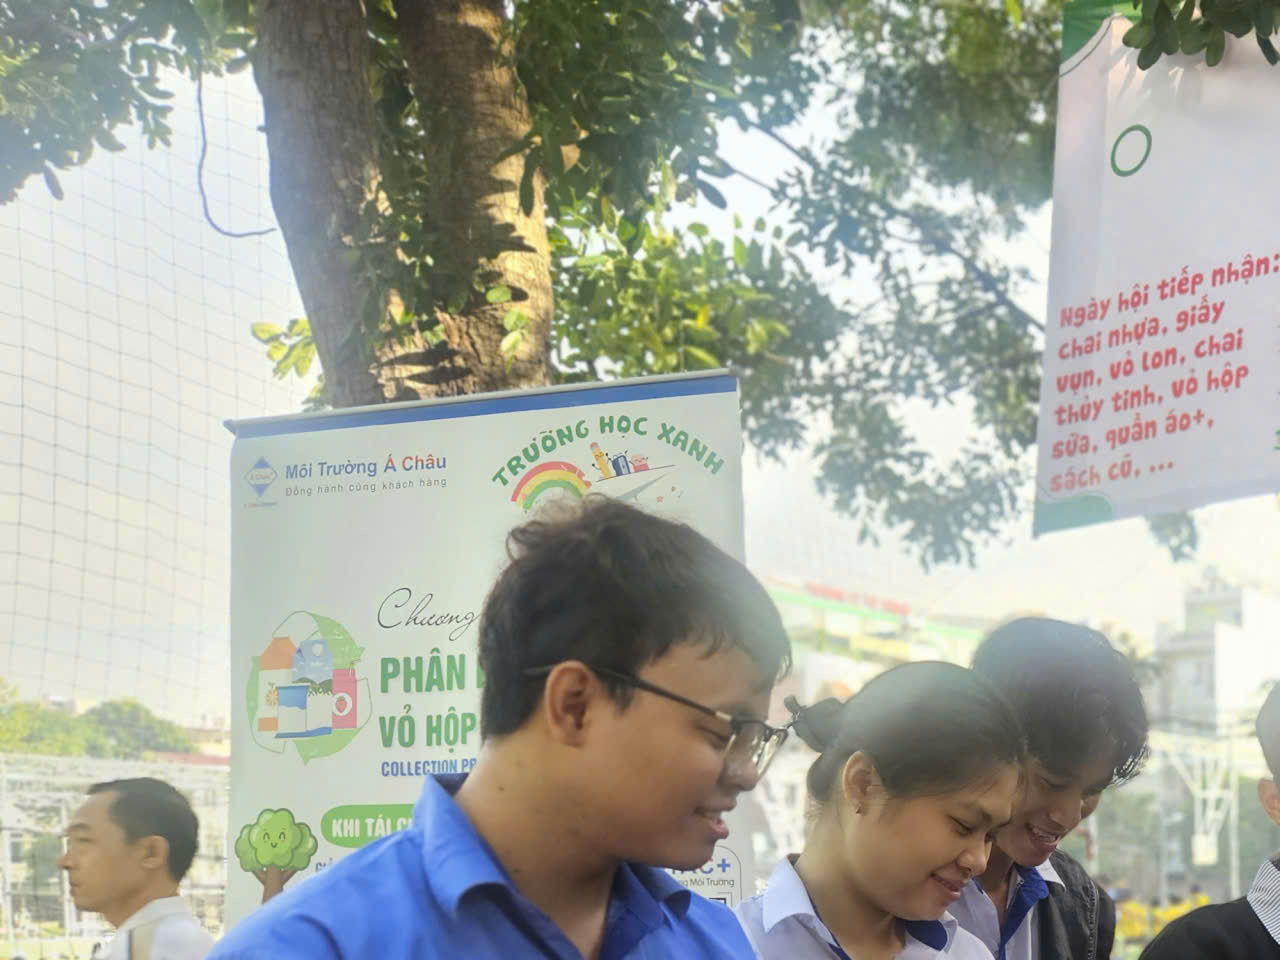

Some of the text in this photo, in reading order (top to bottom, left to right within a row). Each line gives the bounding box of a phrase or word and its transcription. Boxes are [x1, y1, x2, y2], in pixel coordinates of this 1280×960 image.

[1060, 253, 1280, 328] Ngày hội tiếp nhận:
[1058, 334, 1101, 360] chai
[1176, 294, 1225, 333] giấy
[1109, 350, 1134, 380] vỏ
[1194, 328, 1243, 358] chai
[1054, 394, 1104, 426] thủy
[1171, 369, 1198, 398] vỏ
[1206, 361, 1248, 392] hộp
[285, 463, 313, 480] Môi
[318, 459, 378, 477] Trường
[383, 453, 397, 473] Á
[401, 454, 447, 472] Châu
[600, 415, 649, 438] HỌC
[656, 422, 725, 475] XANH
[1050, 465, 1101, 492] sách
[379, 647, 466, 694] PHÂN
[378, 703, 478, 753] VỎ HỘP
[381, 760, 459, 777] COLLECTION
[331, 818, 361, 838] KHI
[365, 813, 392, 837] TÁI
